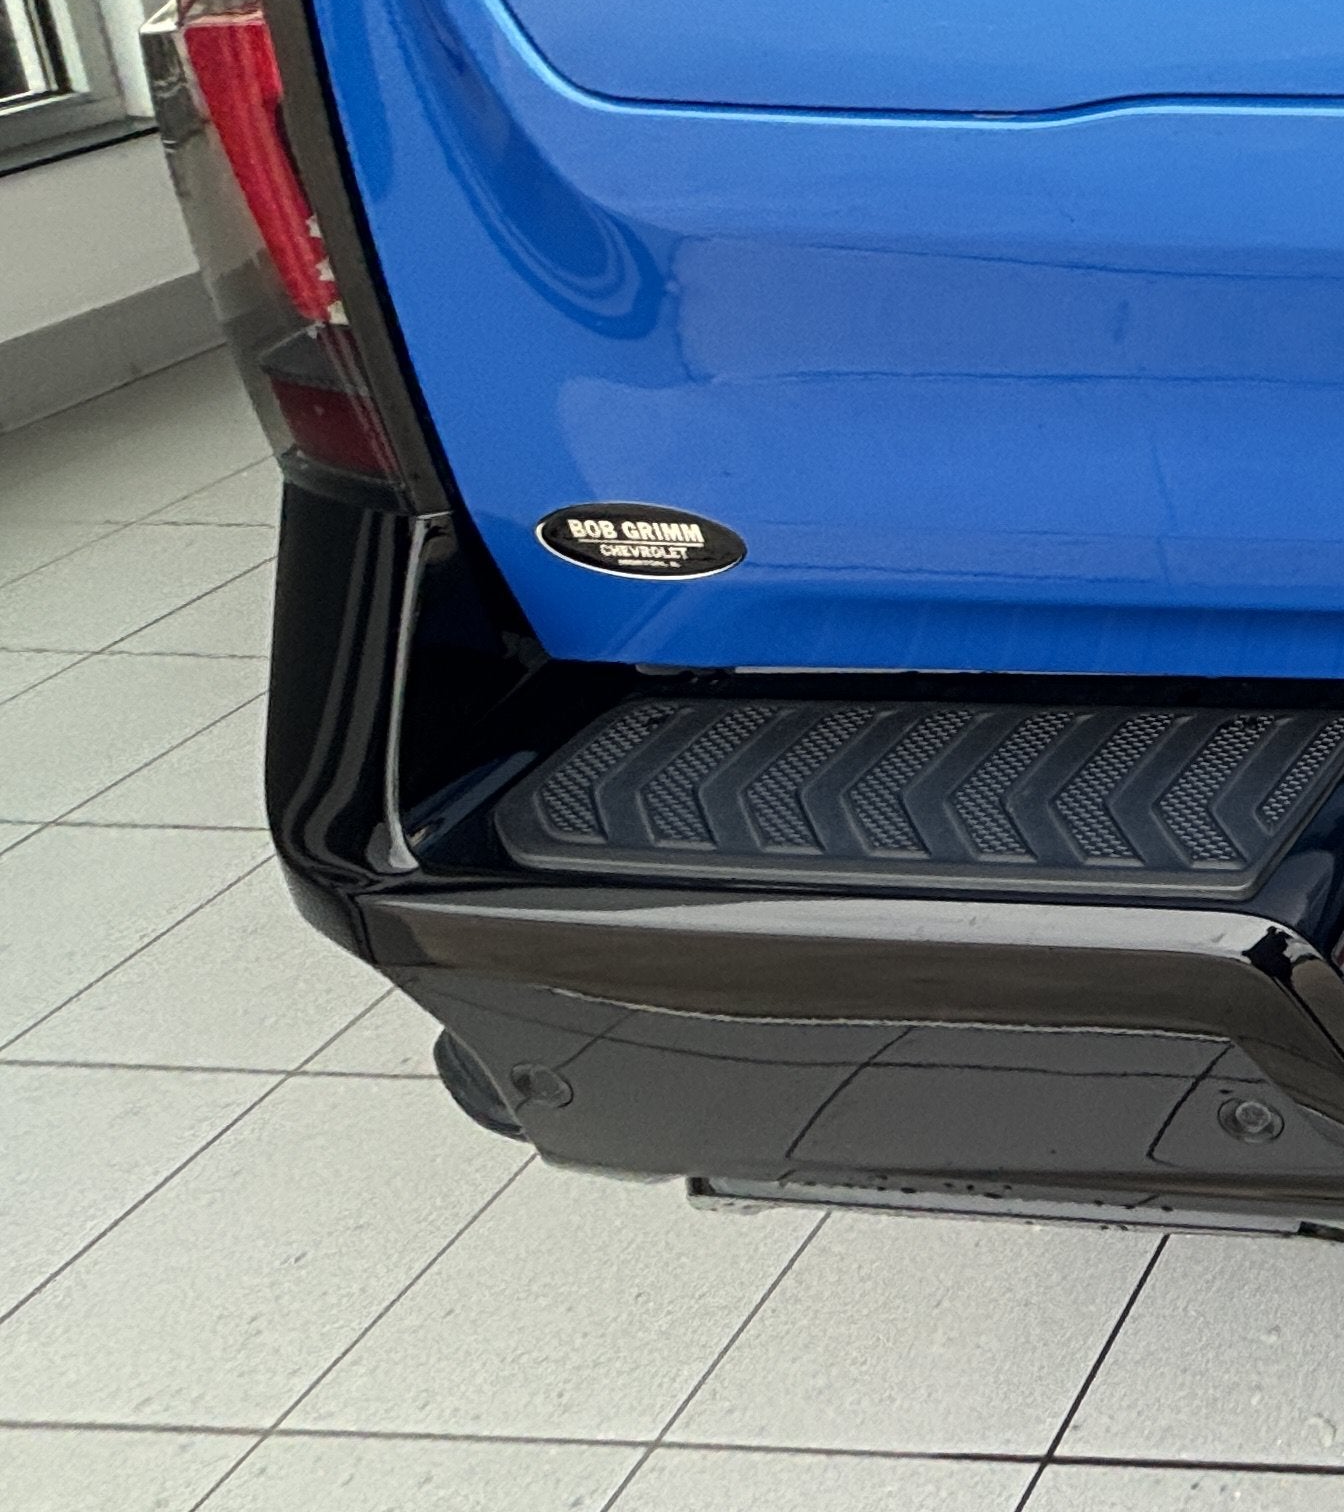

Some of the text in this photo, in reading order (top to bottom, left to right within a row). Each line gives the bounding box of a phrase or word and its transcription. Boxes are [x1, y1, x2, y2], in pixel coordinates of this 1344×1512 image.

[567, 519, 705, 543] BOB GRIMM
[600, 544, 688, 560] CHEVROLET
